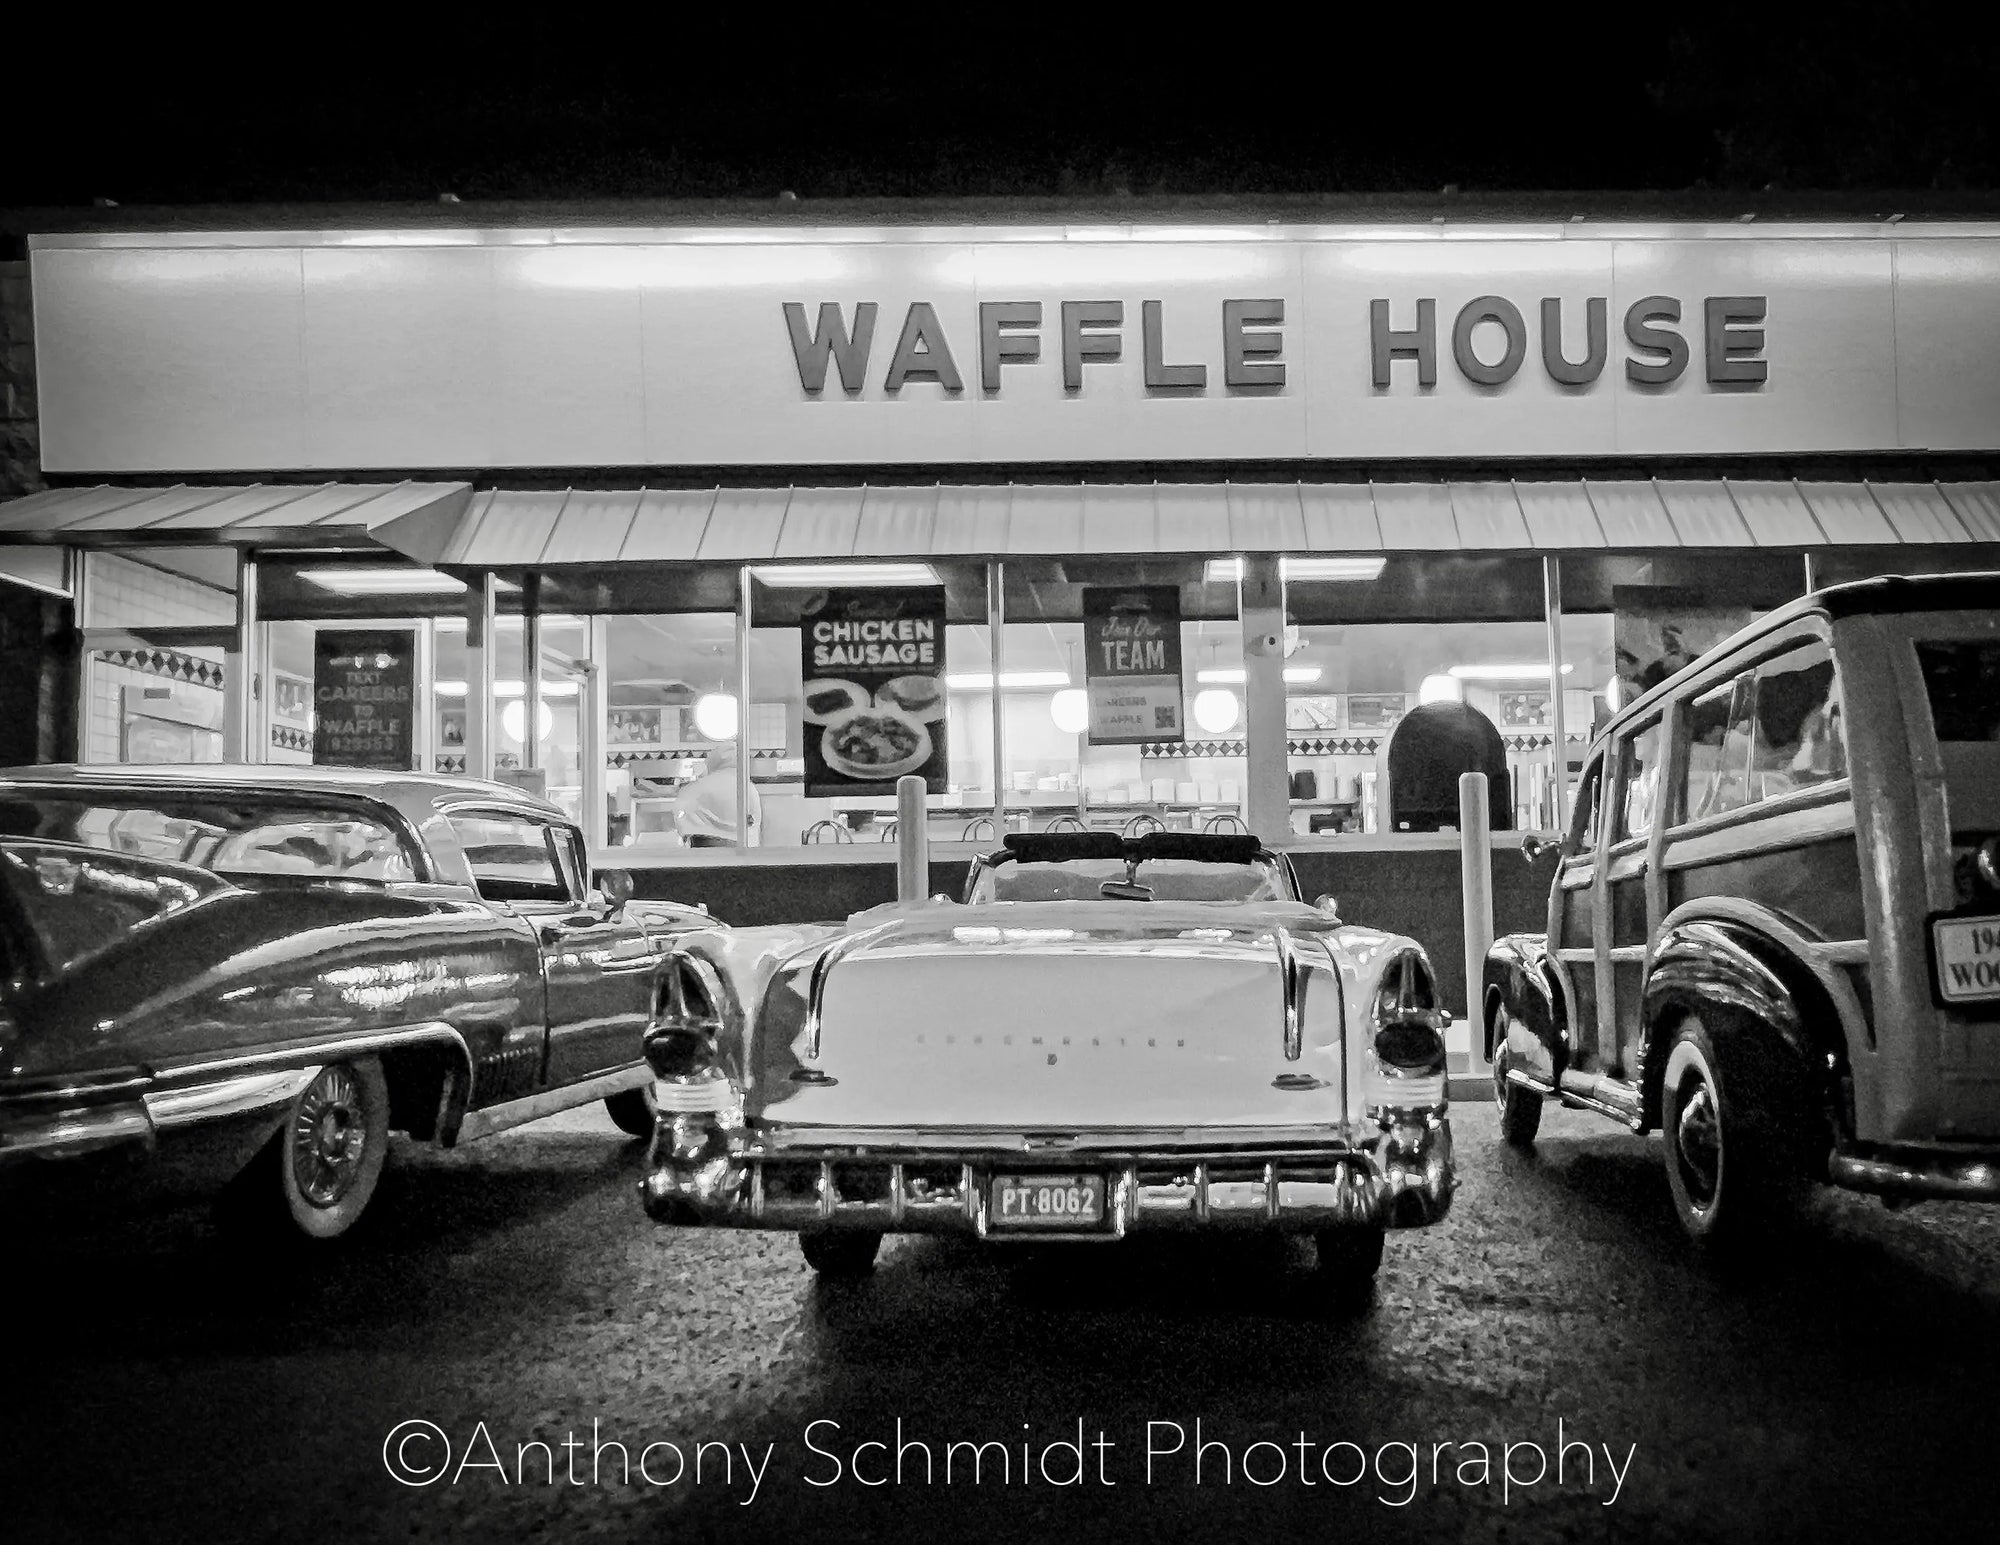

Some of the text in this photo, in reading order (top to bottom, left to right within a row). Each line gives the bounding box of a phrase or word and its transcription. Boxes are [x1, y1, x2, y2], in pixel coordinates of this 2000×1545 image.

[782, 296, 1768, 393] WAFFLE HOUSE
[813, 619, 934, 643] CHICKEN
[814, 642, 934, 666] SAUSAGE
[1101, 640, 1165, 670] TEAM
